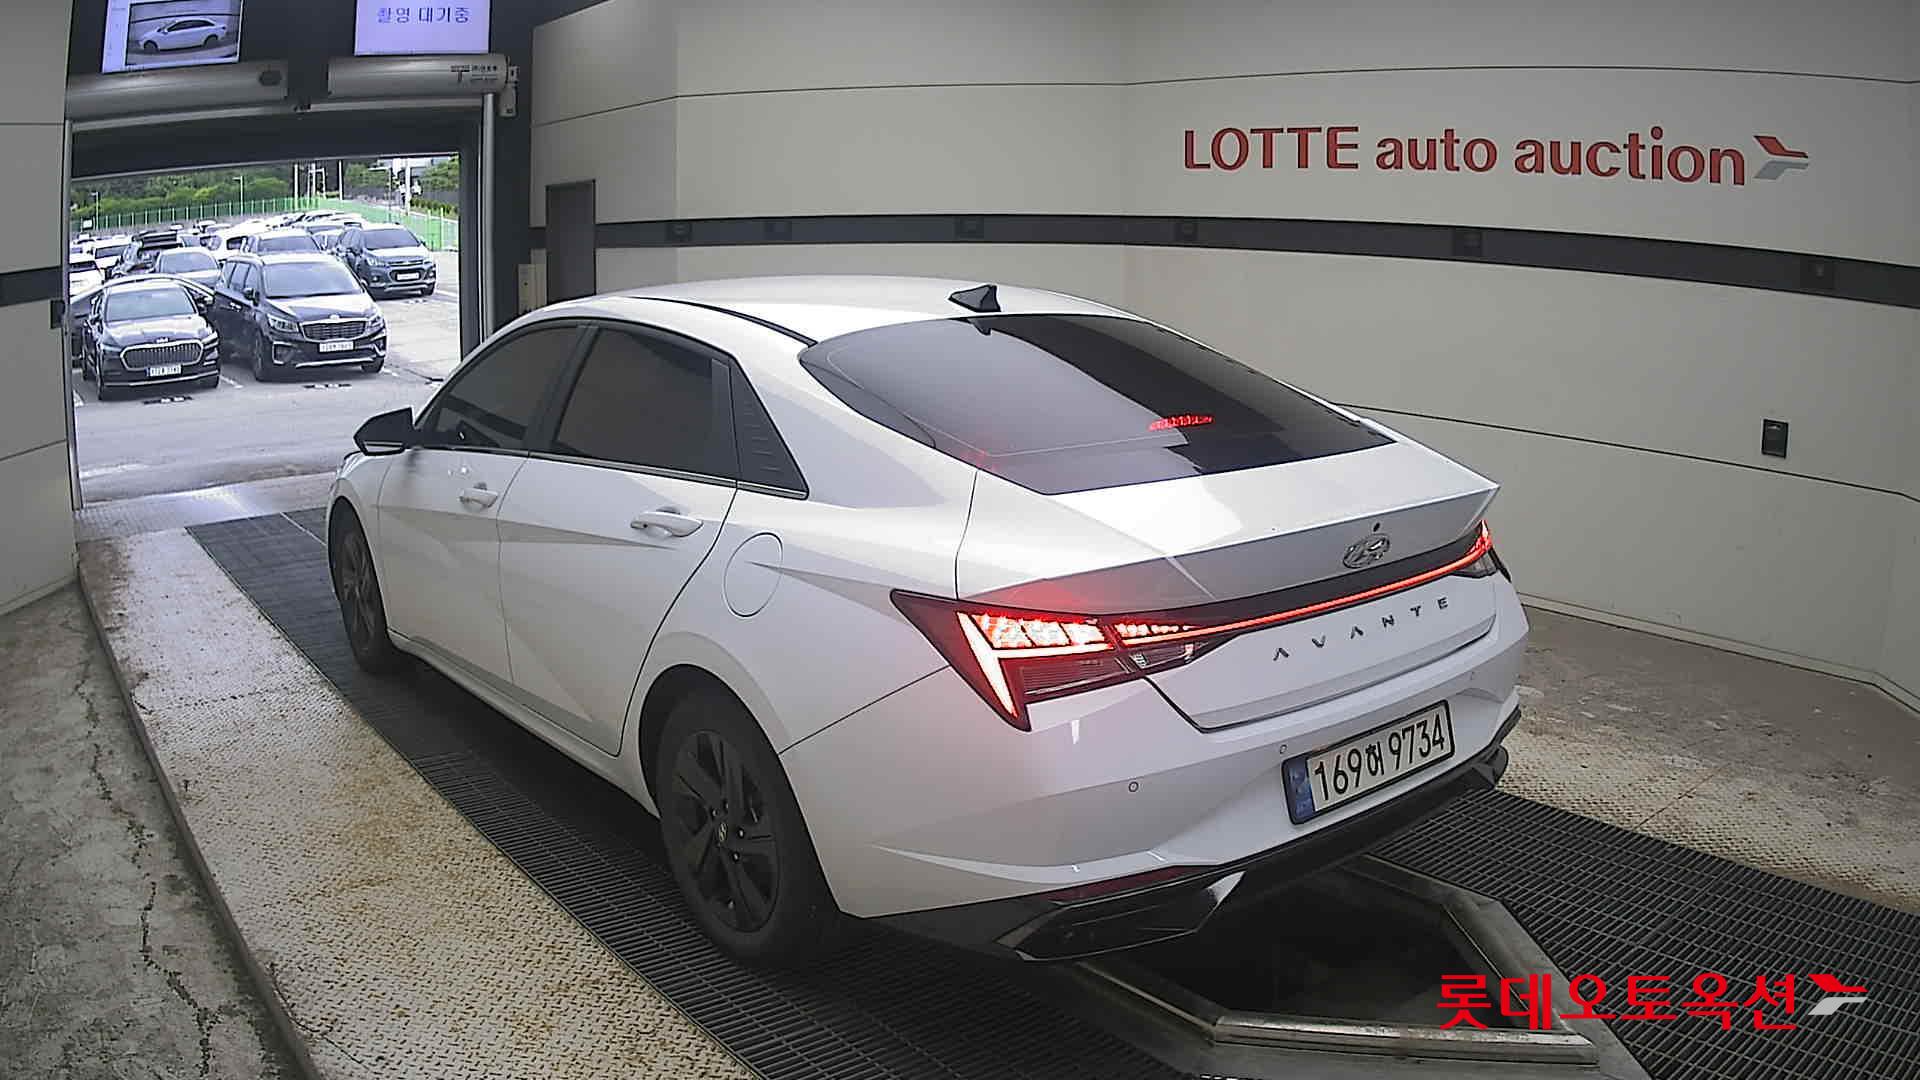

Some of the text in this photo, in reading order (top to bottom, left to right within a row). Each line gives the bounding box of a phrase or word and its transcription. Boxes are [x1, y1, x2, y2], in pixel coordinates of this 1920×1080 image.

[419, 7, 469, 23] 대기중
[1184, 126, 1745, 185] LOTTE auto auction
[1272, 597, 1449, 662] AVANTE
